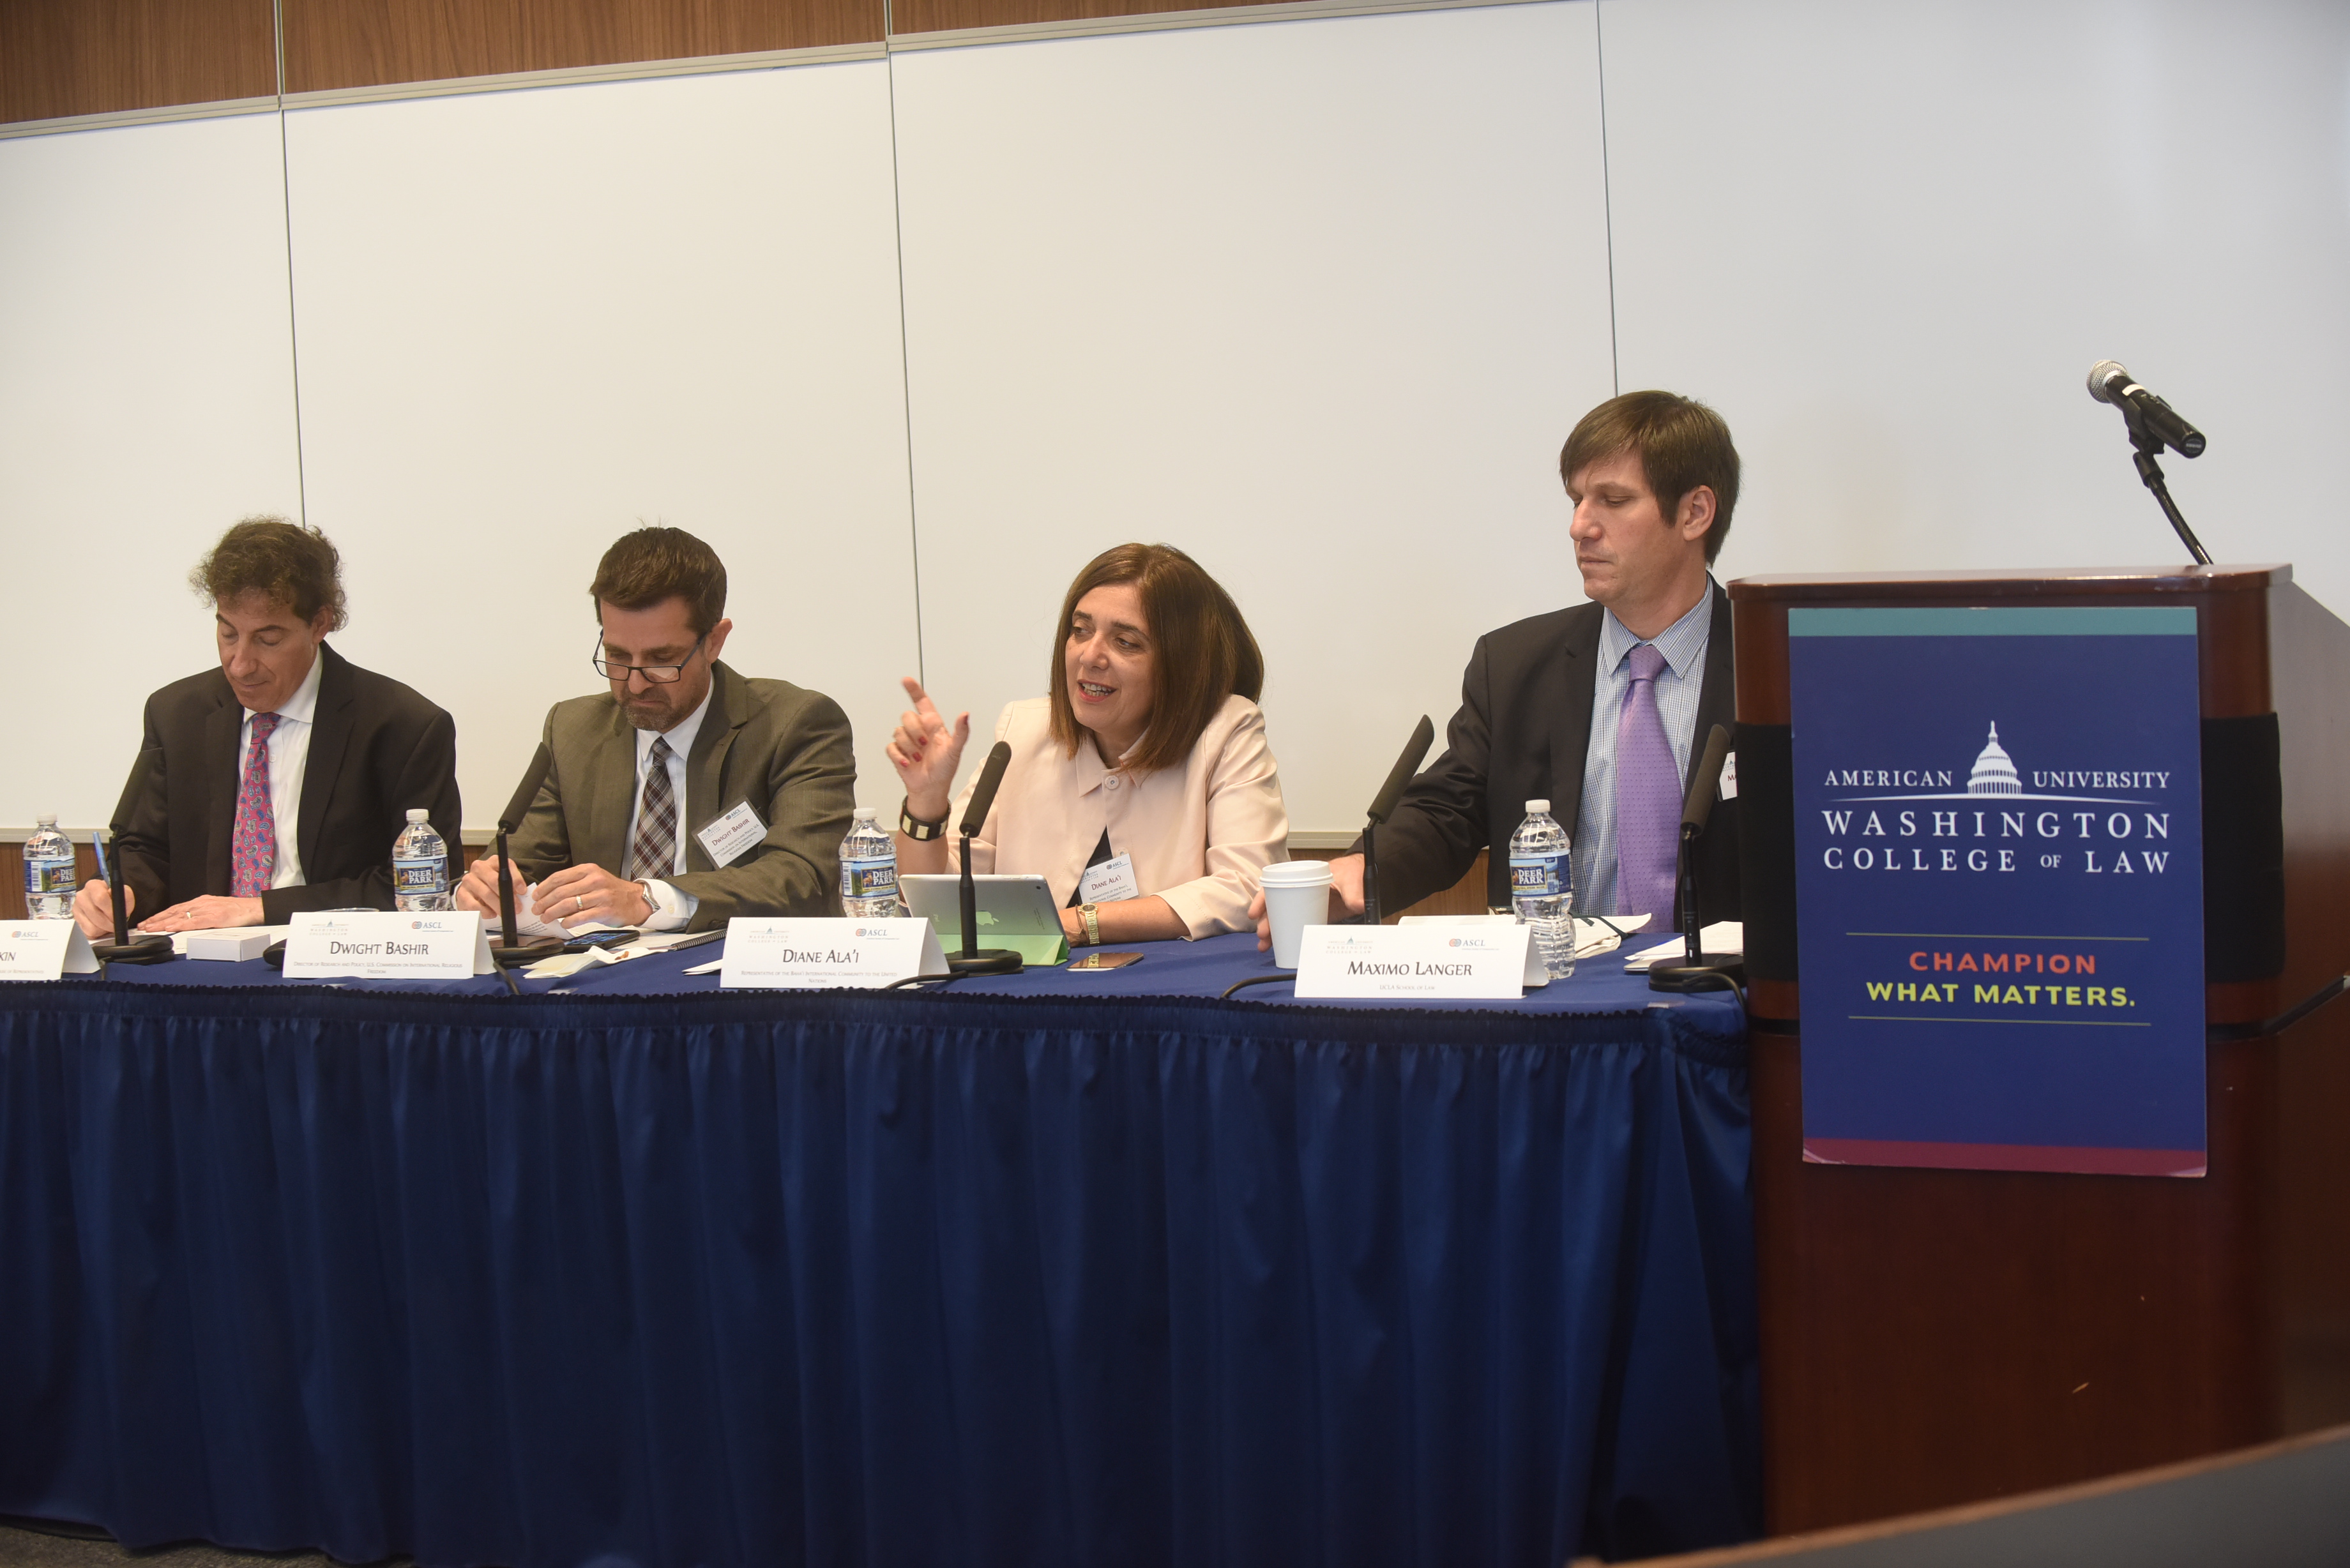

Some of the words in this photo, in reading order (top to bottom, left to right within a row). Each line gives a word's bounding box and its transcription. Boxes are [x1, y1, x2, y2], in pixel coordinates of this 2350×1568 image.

[1824, 770, 1952, 787] AMERICAN
[2033, 771, 2170, 788] UNIVERSITY
[1822, 810, 2170, 839] WASHINGTON
[712, 831, 732, 846] DWIGHT
[731, 818, 750, 833] BASHIR
[1823, 848, 2016, 871] COLLEGE
[2040, 855, 2062, 869] OF
[2085, 850, 2170, 874] LAW
[872, 869, 893, 878] DEER
[1518, 869, 1543, 877] DEER
[873, 877, 894, 886] PARK
[1091, 881, 1108, 890] DIANE
[1519, 876, 1544, 885] PARK
[330, 941, 382, 954] DWIGHT
[386, 942, 429, 955] BASHIR
[783, 949, 822, 963] DIANE
[825, 949, 859, 963] ALA'I
[1909, 951, 2096, 975] CHAMPION
[1347, 961, 1409, 975] MAXIMO
[1415, 962, 1472, 976] LANGER
[1866, 982, 1959, 1002] WHAT
[1975, 984, 2135, 1007] MATTERS.
